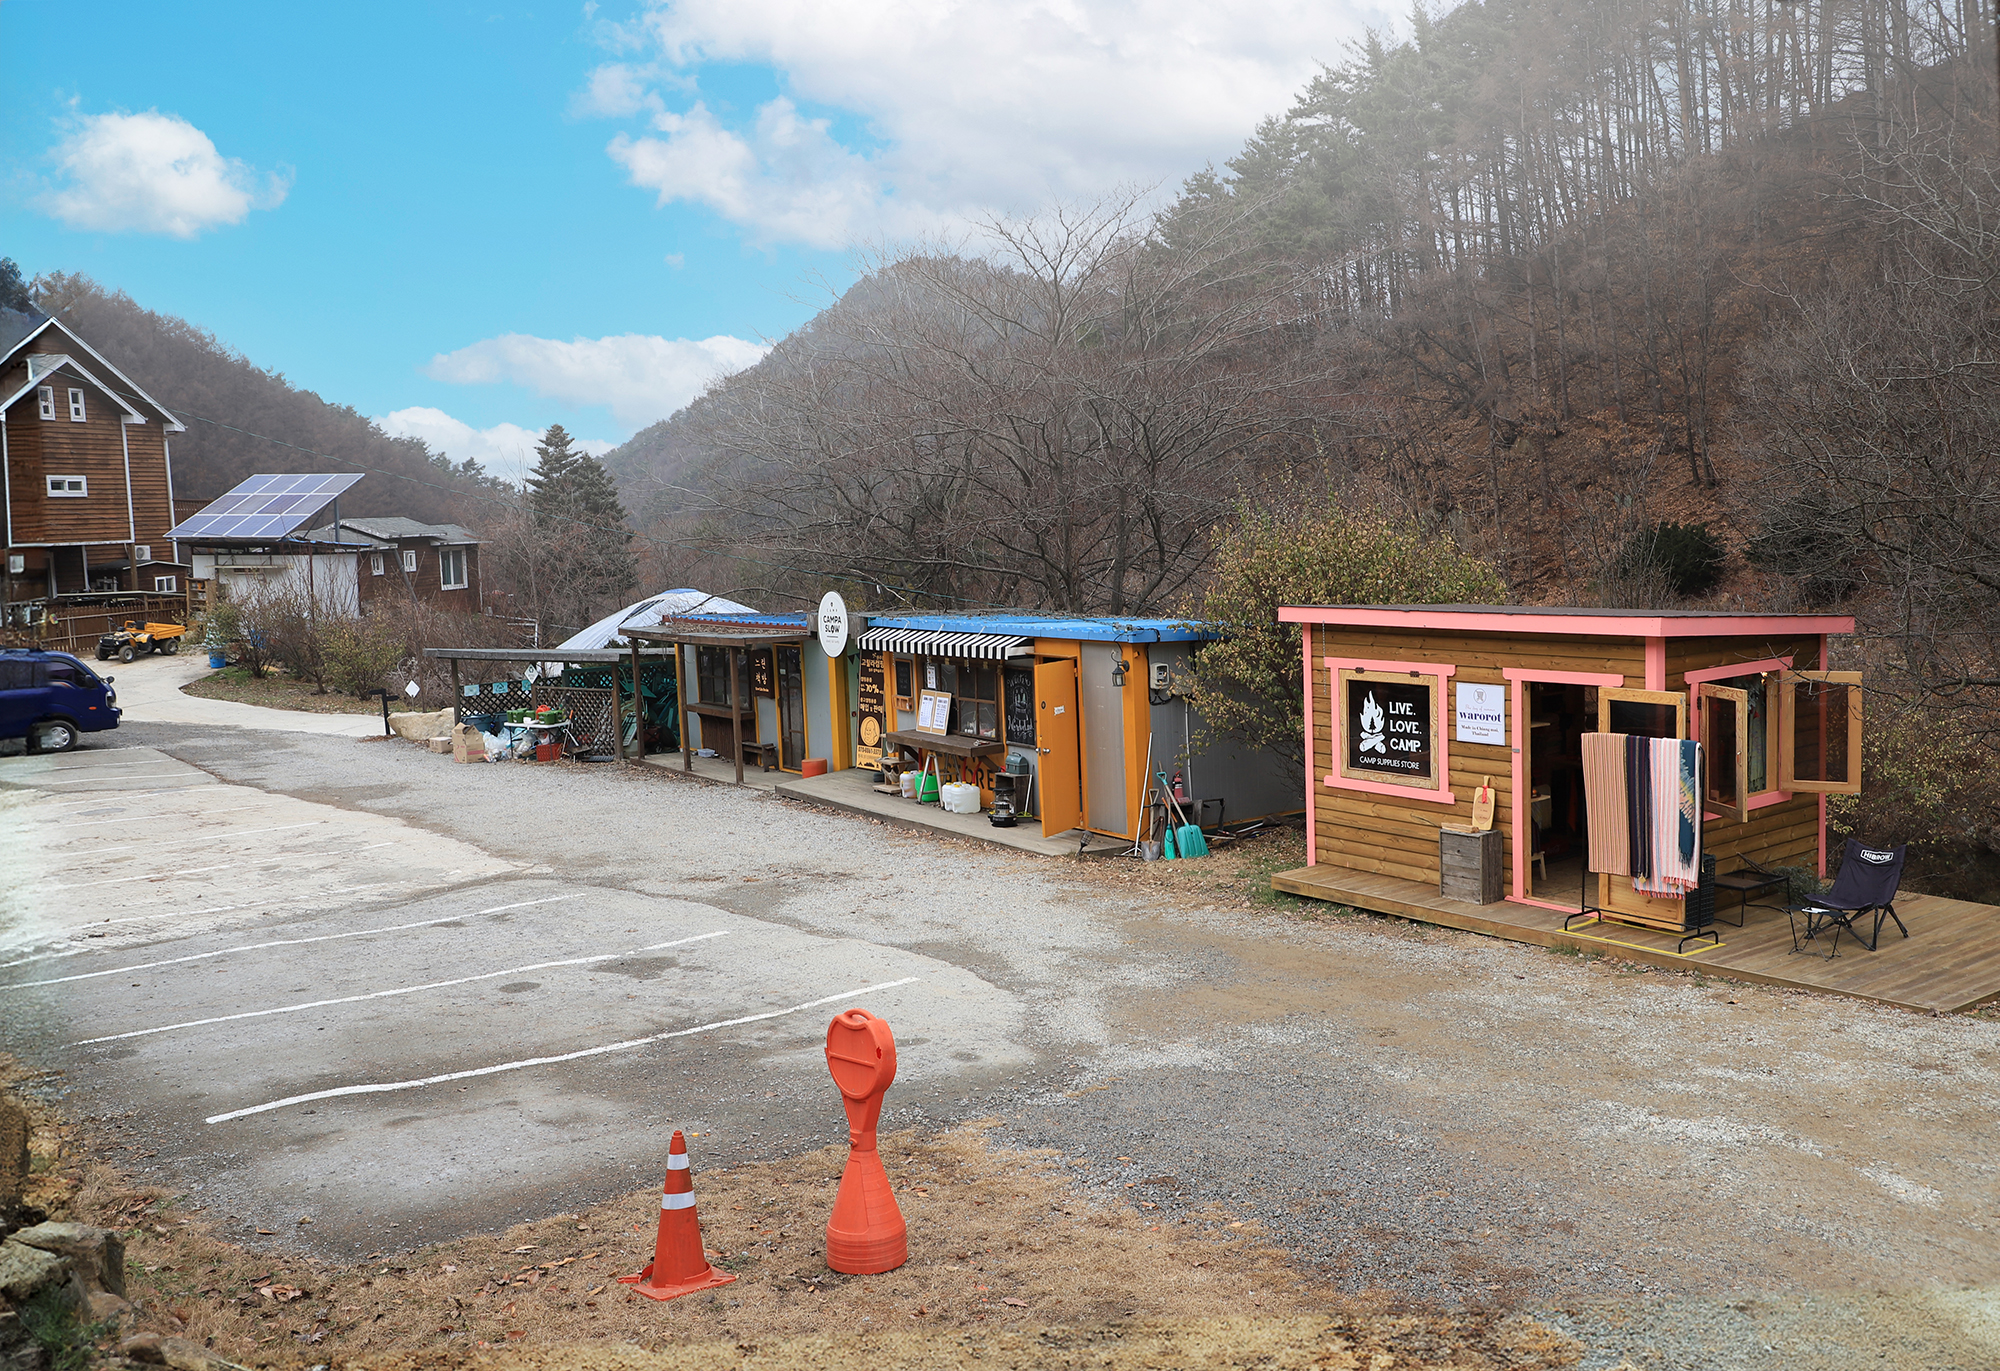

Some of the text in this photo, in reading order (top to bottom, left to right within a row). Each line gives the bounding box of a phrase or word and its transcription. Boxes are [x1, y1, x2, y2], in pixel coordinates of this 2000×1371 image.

[823, 615, 842, 623] CAMPA
[825, 624, 841, 633] SLOW
[754, 657, 766, 669] 느린
[755, 671, 768, 685] 책방
[865, 683, 880, 694] 70%
[1389, 701, 1416, 716] LIVE.
[1459, 711, 1502, 723] warorot
[1389, 719, 1422, 734] LOVE.
[1389, 737, 1422, 753] CAMP.
[1359, 755, 1420, 770] CAMP SUPPLIES STORE
[1863, 850, 1891, 861] HIBROW
